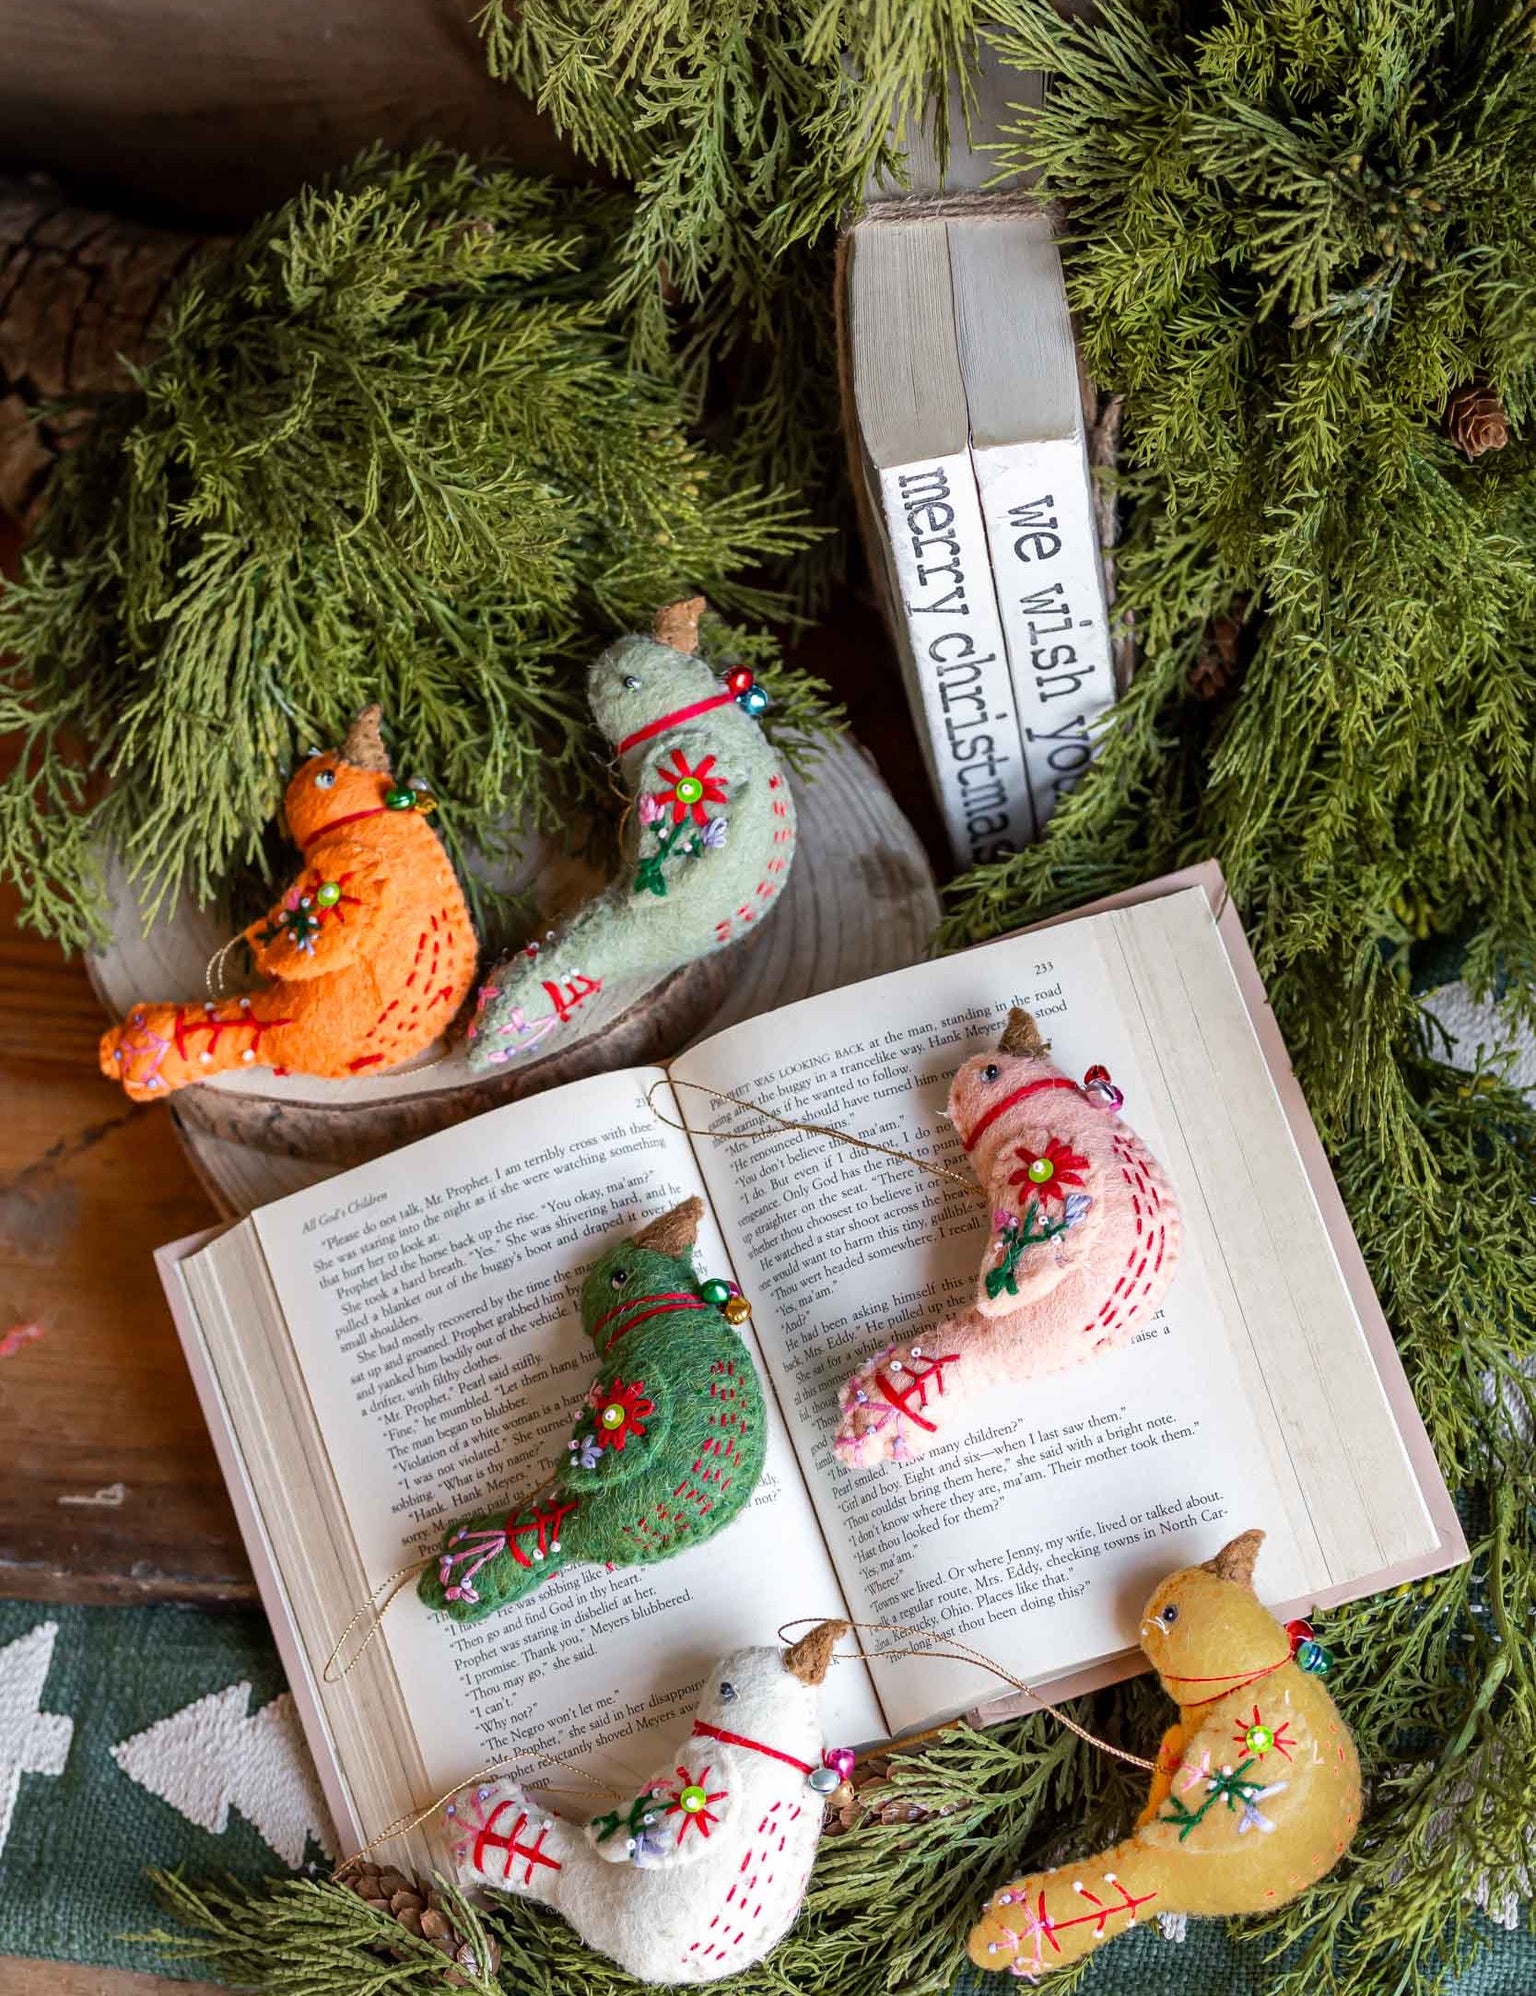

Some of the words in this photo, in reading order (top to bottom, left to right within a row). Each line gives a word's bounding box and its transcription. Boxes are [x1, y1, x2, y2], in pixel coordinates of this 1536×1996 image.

[898, 466, 969, 616] merry
[1008, 494, 1062, 562] we
[1020, 583, 1095, 702] wish
[929, 632, 1009, 867] christmas
[1034, 961, 1054, 975] 233
[753, 1073, 775, 1087] WAS
[778, 1053, 831, 1079] LOOKING
[834, 1043, 865, 1059] BACK
[869, 1039, 880, 1049] at
[884, 1031, 903, 1044] the
[941, 1007, 992, 1028] standing
[1035, 982, 1062, 1001] road
[758, 1092, 775, 1105] the
[776, 1078, 811, 1096] buggy
[840, 1050, 897, 1075] trancelike
[928, 1030, 962, 1048] Hank
[1035, 998, 1068, 1018] stood
[812, 1078, 854, 1101] wanted
[871, 1495, 907, 1518] couldst
[908, 1485, 941, 1502] bring
[943, 1474, 973, 1490] them
[1016, 1453, 1036, 1467] she
[1039, 1442, 1064, 1460] said
[1066, 1435, 1093, 1452] with
[1105, 1422, 1143, 1440] bright
[903, 1466, 935, 1485] Eight
[938, 1455, 961, 1473] and
[1037, 1429, 1059, 1442] last
[1062, 1423, 1084, 1435] saw
[928, 1441, 959, 1458] many
[880, 1514, 909, 1532] know
[912, 1501, 947, 1519] where
[949, 1491, 974, 1506] they
[1047, 1459, 1081, 1475] Their
[1085, 1446, 1127, 1465] mother
[1130, 1434, 1158, 1452] took
[901, 1517, 941, 1542] looked
[943, 1513, 960, 1527] for
[948, 1567, 965, 1580] Or
[967, 1556, 1004, 1574] where
[1096, 1515, 1127, 1534] lived
[1145, 1499, 1183, 1520] talked
[538, 1579, 581, 1601] sobbing
[581, 1569, 602, 1584] like
[899, 1598, 934, 1620] regular
[1046, 1545, 1101, 1567] checking
[1103, 1534, 1140, 1551] towns
[1159, 1514, 1198, 1534] North
[975, 1590, 1014, 1608] Places
[1015, 1580, 1039, 1595] like
[454, 1648, 498, 1671] Prophet
[500, 1640, 520, 1653] was
[522, 1625, 559, 1645] staring
[574, 1596, 619, 1624] disbelief
[503, 1616, 523, 1634] and
[525, 1606, 547, 1625] find
[549, 1595, 574, 1615] God
[590, 1586, 607, 1599] thy
[958, 1617, 986, 1633] thou
[986, 1607, 1017, 1623] been
[1020, 1596, 1056, 1612] doing
[521, 1641, 557, 1663] Thank
[590, 1615, 630, 1637] Meyers
[502, 1675, 524, 1690] may
[553, 1656, 570, 1670] she
[568, 1724, 586, 1739] she
[589, 1711, 611, 1731] said
[625, 1703, 644, 1716] her
[578, 1703, 593, 1716] let
